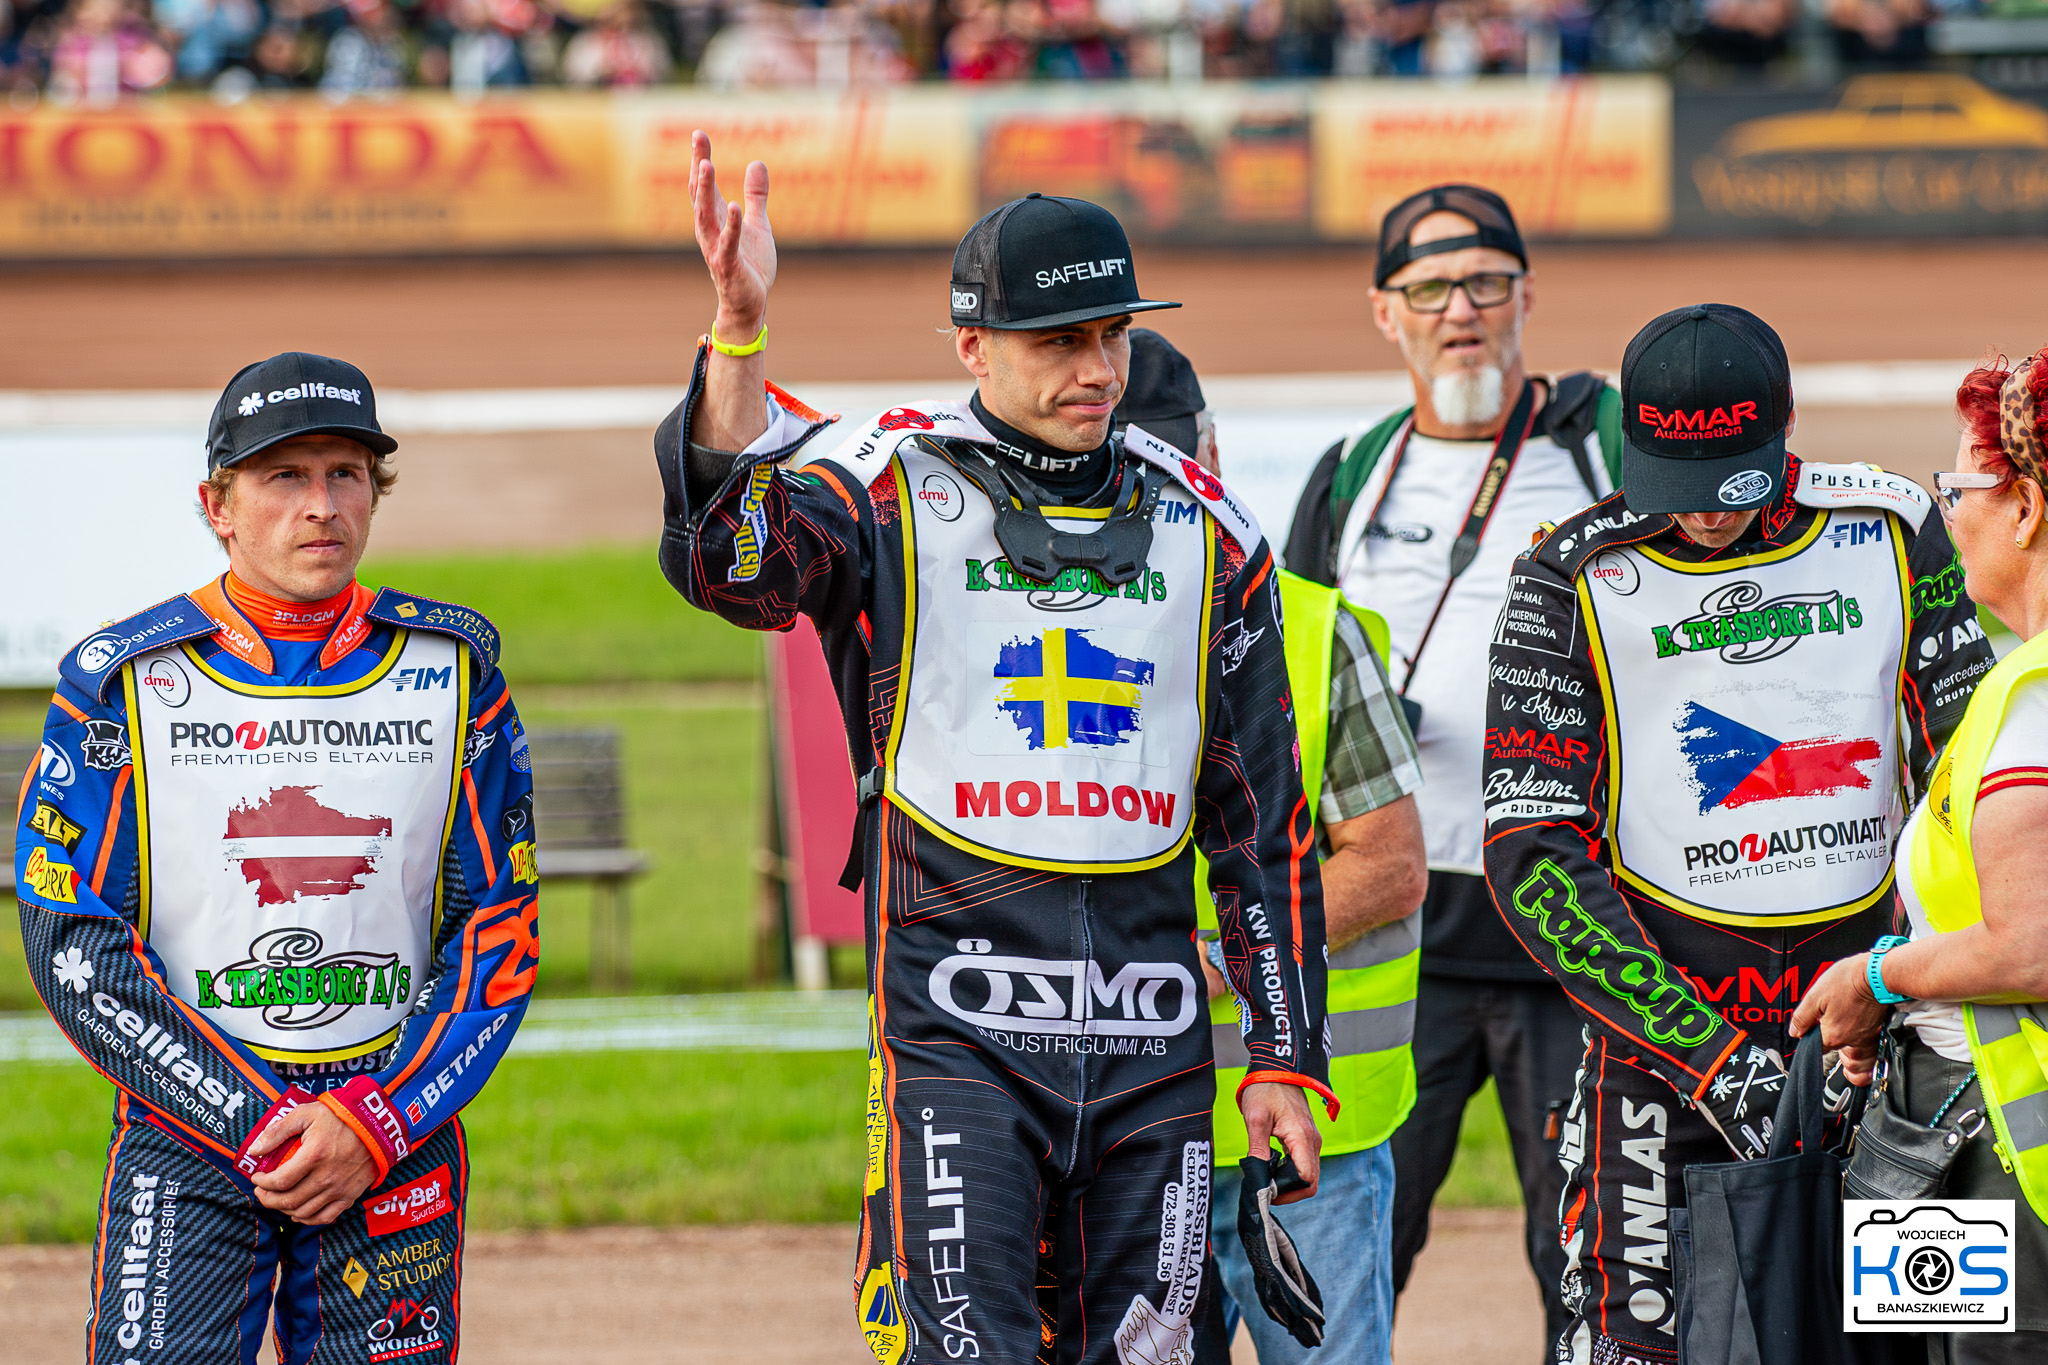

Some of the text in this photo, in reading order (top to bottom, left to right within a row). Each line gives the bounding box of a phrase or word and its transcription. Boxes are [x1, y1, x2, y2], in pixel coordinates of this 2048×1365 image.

[267, 381, 361, 407] cellfast
[1638, 400, 1759, 432] EvMAR
[1654, 424, 1743, 441] Automation
[855, 441, 875, 461] NJ
[1145, 438, 1165, 454] NJ
[918, 487, 949, 501] dmu
[1823, 519, 1883, 549] FIM
[965, 558, 1167, 605] E. TRBOR A/S
[1593, 567, 1624, 579] dmu
[273, 609, 335, 623] 3PLDGM
[428, 607, 495, 643] AMBER
[1506, 620, 1557, 640] PROSZKOWA
[1651, 594, 1863, 659] E. TRASBORG A/S
[423, 615, 495, 664] STUDIOS
[143, 674, 175, 688] dmu
[387, 665, 453, 692] FIM
[1520, 691, 1587, 731] Krysi
[1935, 684, 1974, 708] GRUPA
[171, 751, 433, 767] FREMTIDENS ELTAVLER
[1484, 726, 1590, 765] EvMAR
[1491, 747, 1572, 771] Automation
[955, 780, 1177, 829] MOLDOW
[1510, 803, 1554, 814] RIDER
[1688, 855, 1817, 888] FREMTIDENS
[196, 960, 412, 1011] E. TRASBORG A/S
[1245, 902, 1293, 1058] KW PRODUCTS
[92, 991, 247, 1120] cellfast
[975, 1025, 1167, 1057] INDUSTRIGUMMI AB
[77, 1008, 226, 1135] GARDEN ACCESSORIES
[422, 1012, 508, 1110] BETARD
[1620, 1096, 1670, 1271] ANLAS
[410, 1199, 447, 1223] Sports Bar
[923, 1123, 980, 1359] SAFELIFT
[1160, 1185, 1178, 1279] 072-303 51 56
[1164, 1147, 1196, 1316] SCHAKT & MARKTJÄNST
[1178, 1147, 1210, 1317] FORSSBLADS
[117, 1173, 160, 1350] cellfast
[148, 1179, 182, 1350] GARDEN ACCESSORIES
[376, 1238, 442, 1271] AMBER
[377, 1252, 452, 1292] STUDIOS
[378, 1292, 436, 1332] MX
[367, 1329, 441, 1355] WORLD
